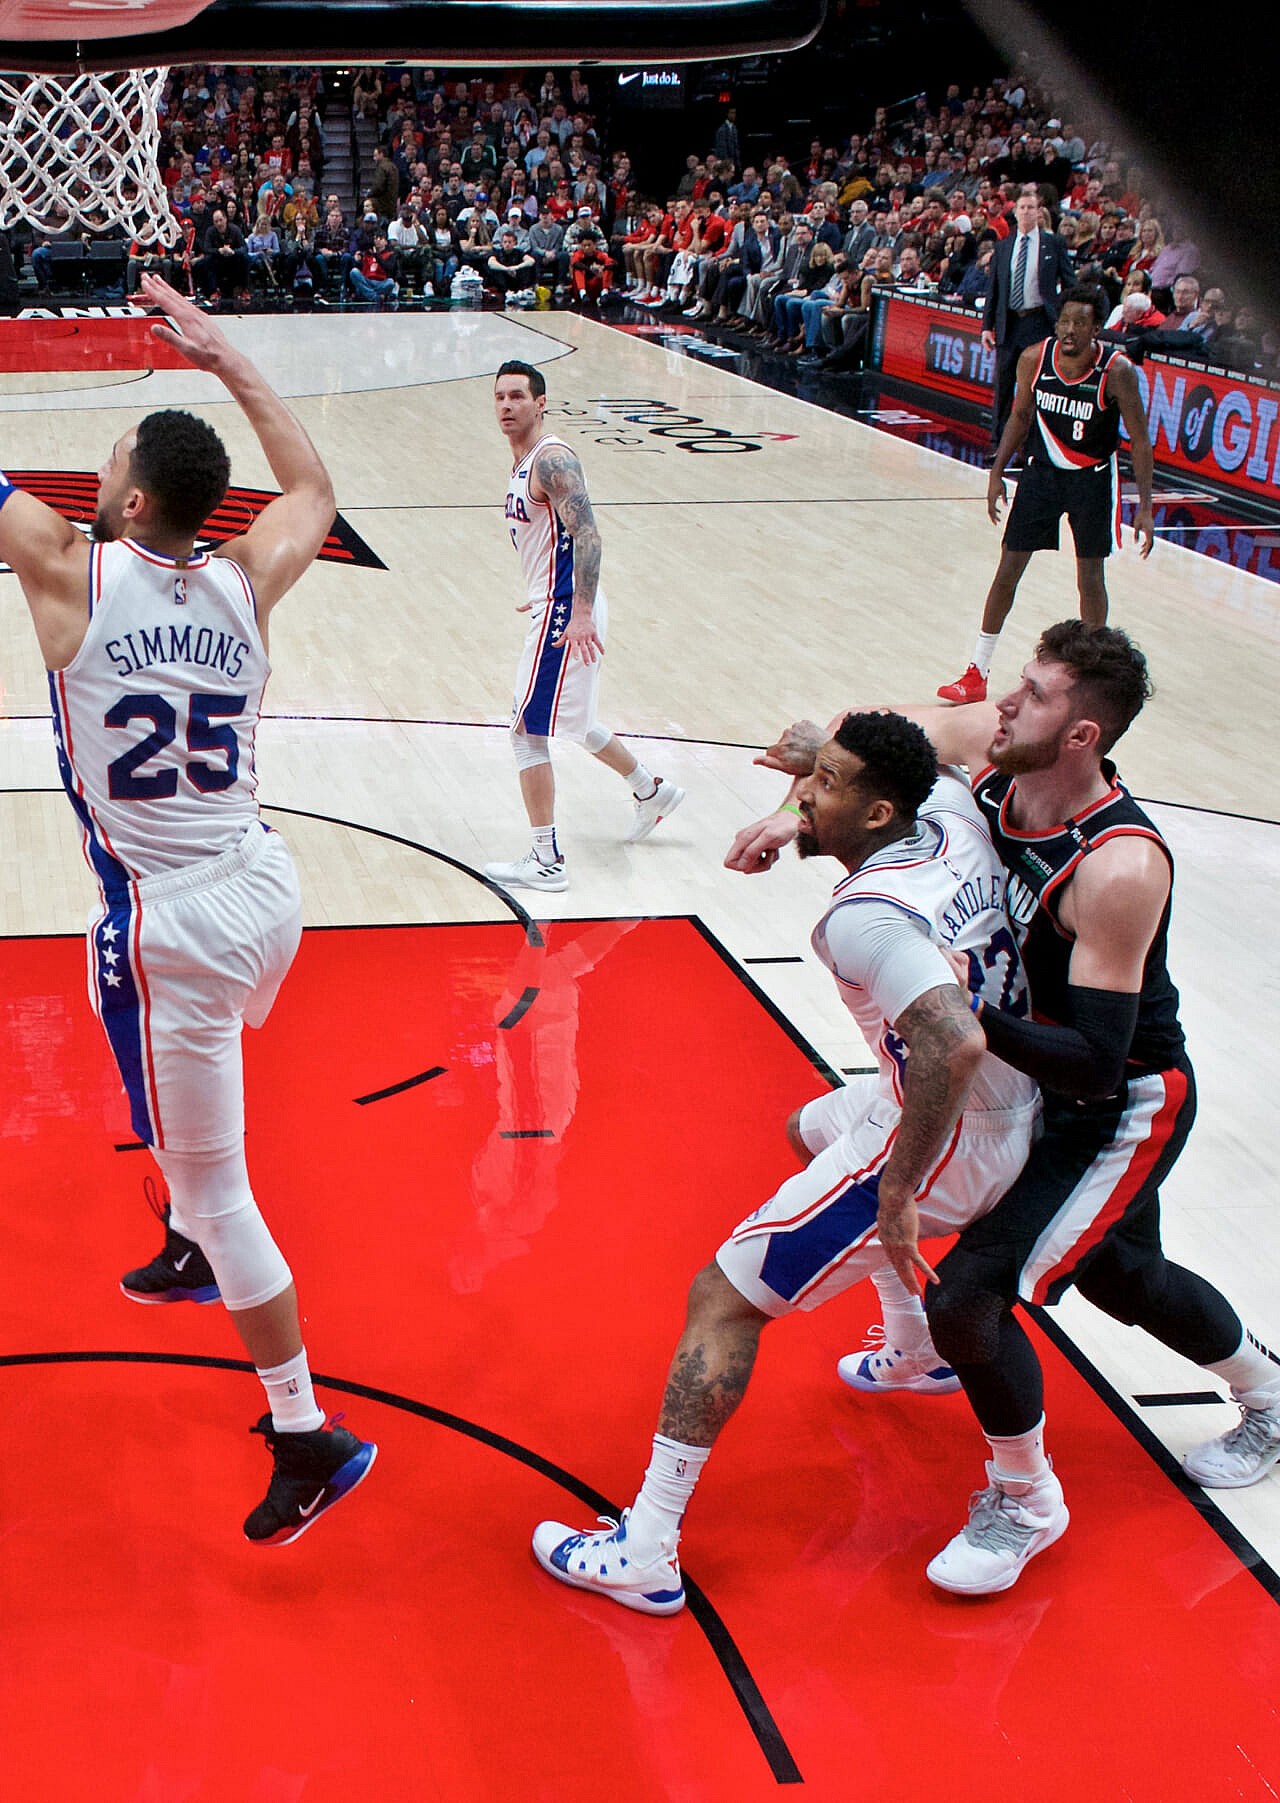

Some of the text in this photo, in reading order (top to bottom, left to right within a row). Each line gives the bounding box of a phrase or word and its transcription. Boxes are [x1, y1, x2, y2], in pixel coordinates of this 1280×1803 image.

[642, 71, 658, 87] Just
[660, 71, 670, 85] do
[970, 343, 996, 384] TH
[587, 399, 766, 454] moda
[1036, 389, 1093, 420] PORTLAND
[1072, 420, 1084, 441] 8
[1185, 398, 1213, 451] of
[1213, 390, 1280, 486] GI
[105, 625, 249, 678] SIMMONS
[104, 693, 248, 800] 25
[939, 875, 1007, 945] ANDLE
